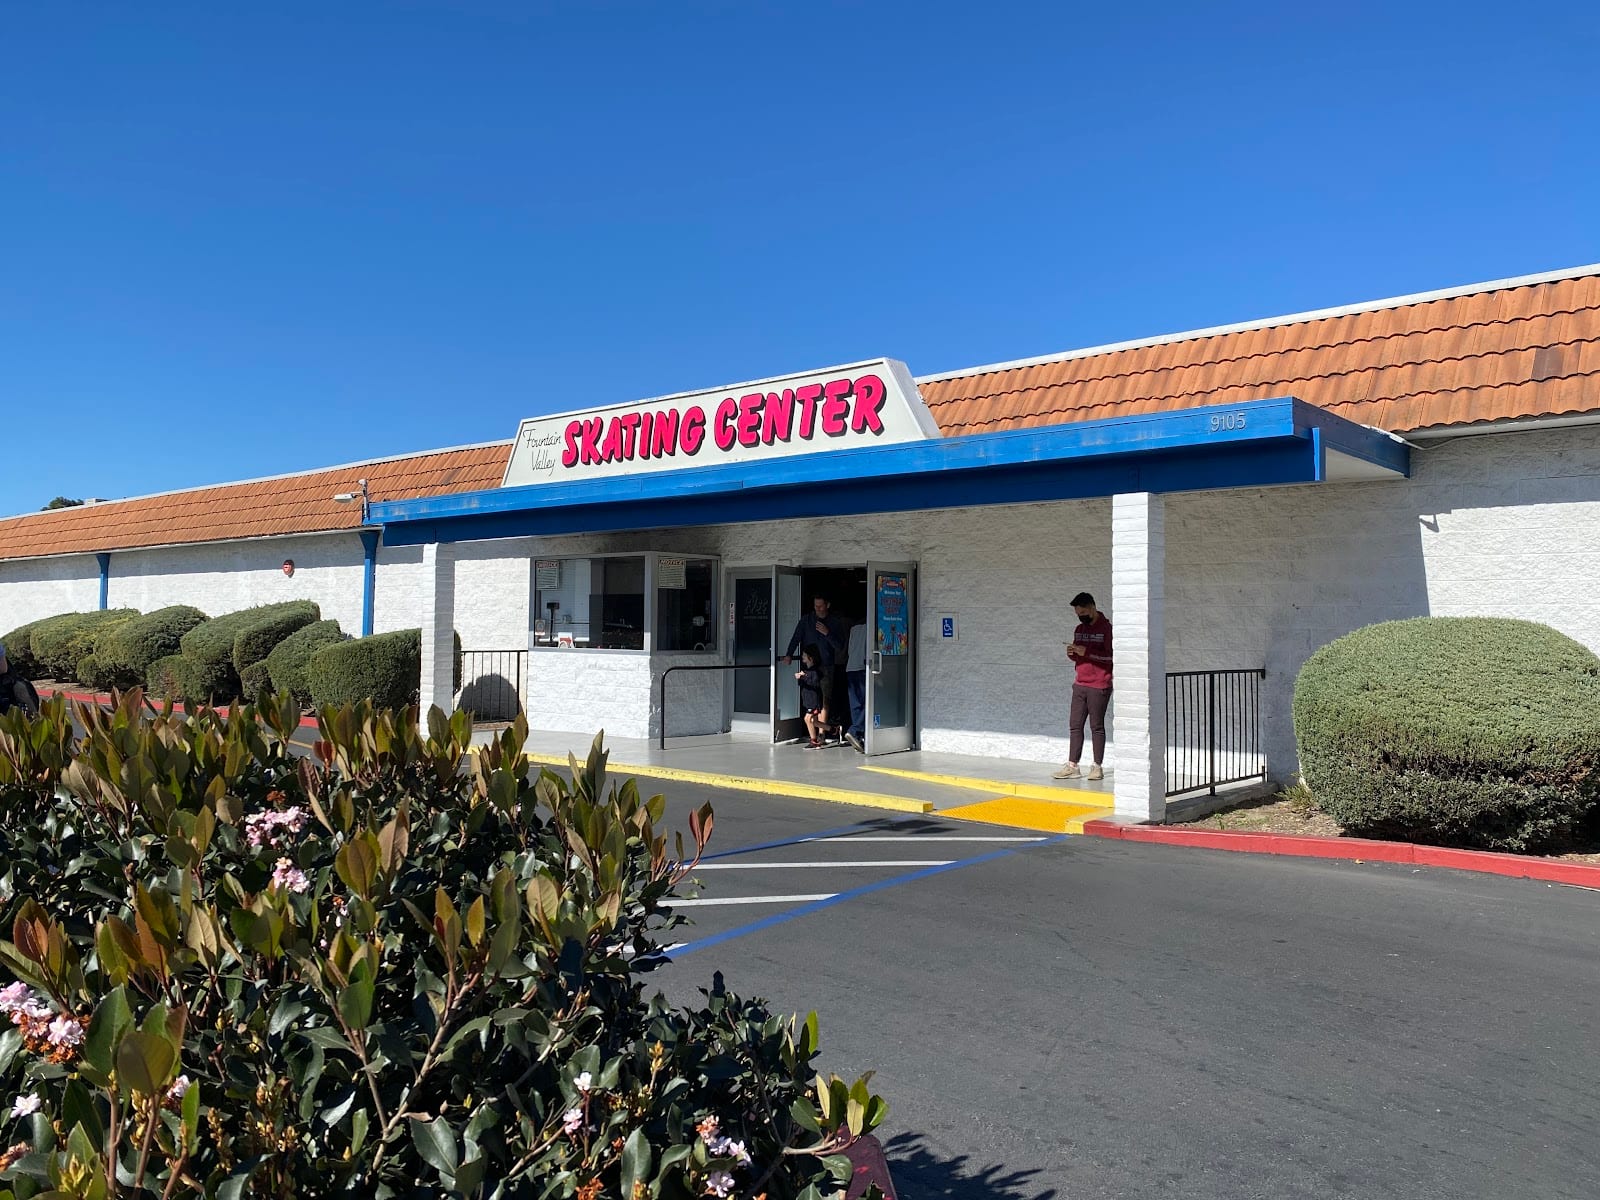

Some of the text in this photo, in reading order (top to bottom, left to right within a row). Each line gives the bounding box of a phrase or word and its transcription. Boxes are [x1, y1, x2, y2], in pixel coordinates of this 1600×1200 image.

[562, 374, 887, 468] SKATING CENTER
[1211, 412, 1246, 432] 9105
[523, 428, 562, 449] Fountain
[531, 450, 556, 476] Valley
